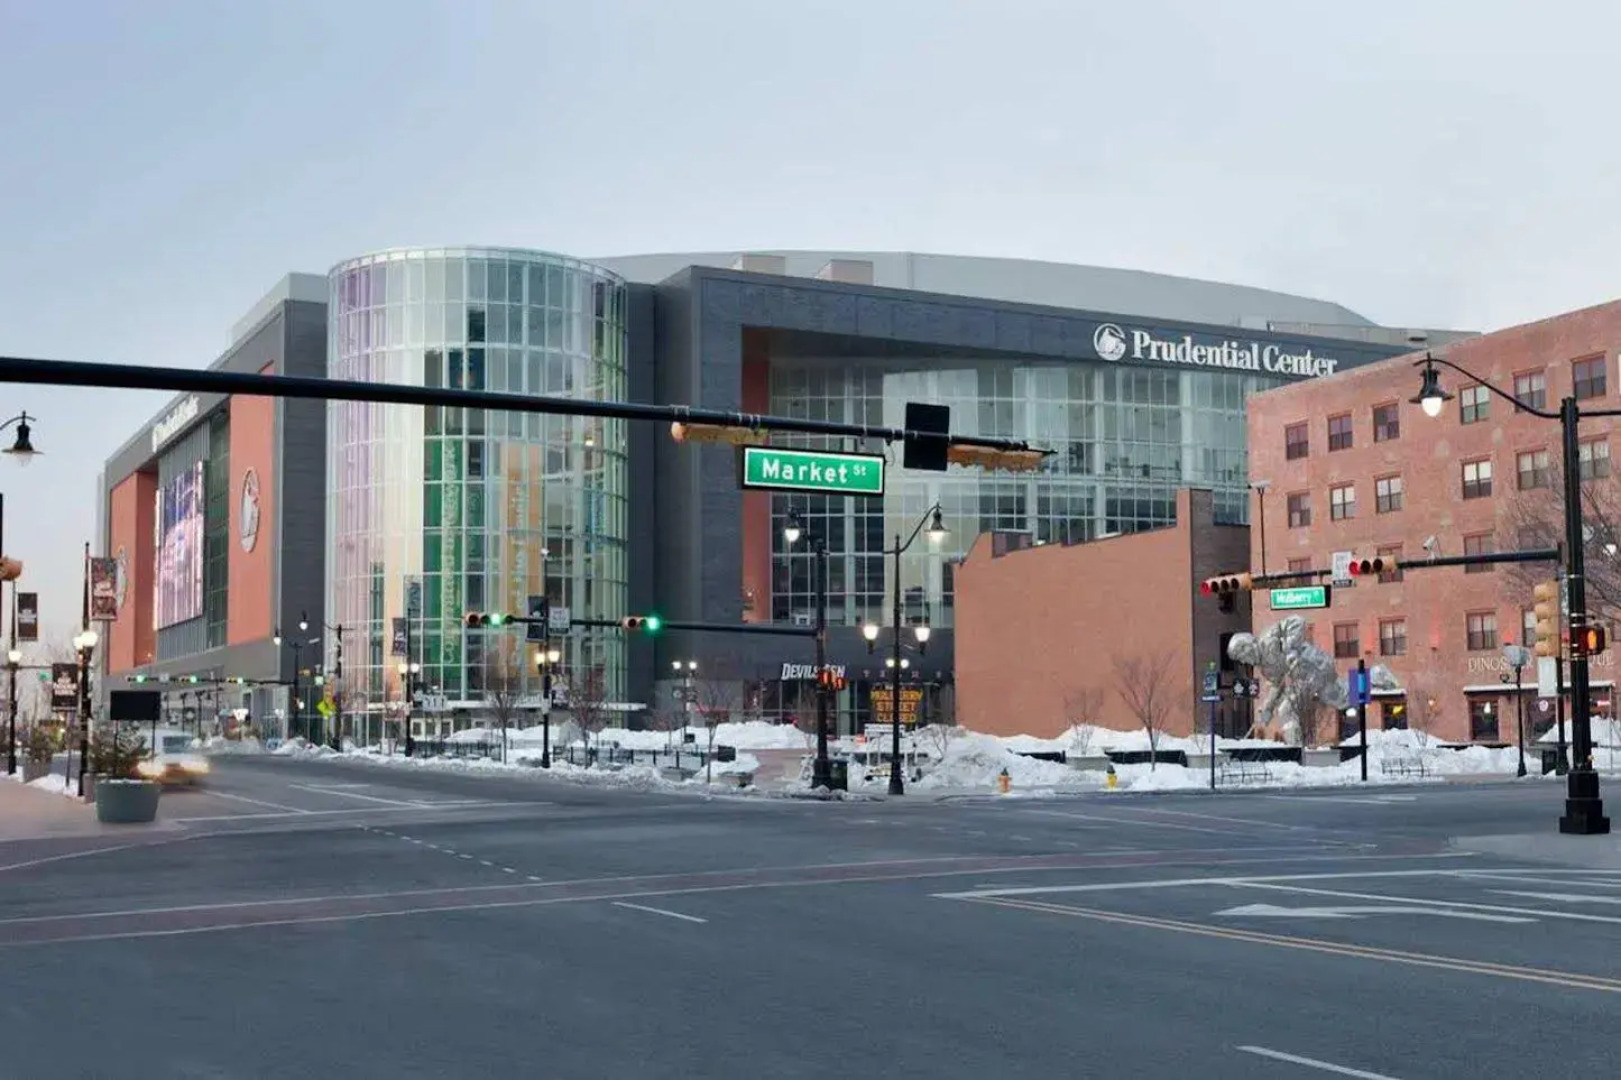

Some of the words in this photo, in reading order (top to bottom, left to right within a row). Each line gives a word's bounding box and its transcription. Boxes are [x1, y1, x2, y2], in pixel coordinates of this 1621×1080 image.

[1131, 330, 1260, 370] Prudential
[1263, 345, 1338, 377] Center
[762, 458, 848, 484] Market
[853, 464, 867, 477] St
[780, 663, 819, 681] DEVILS
[822, 663, 846, 679] EN
[1468, 654, 1533, 672] DINOSR
